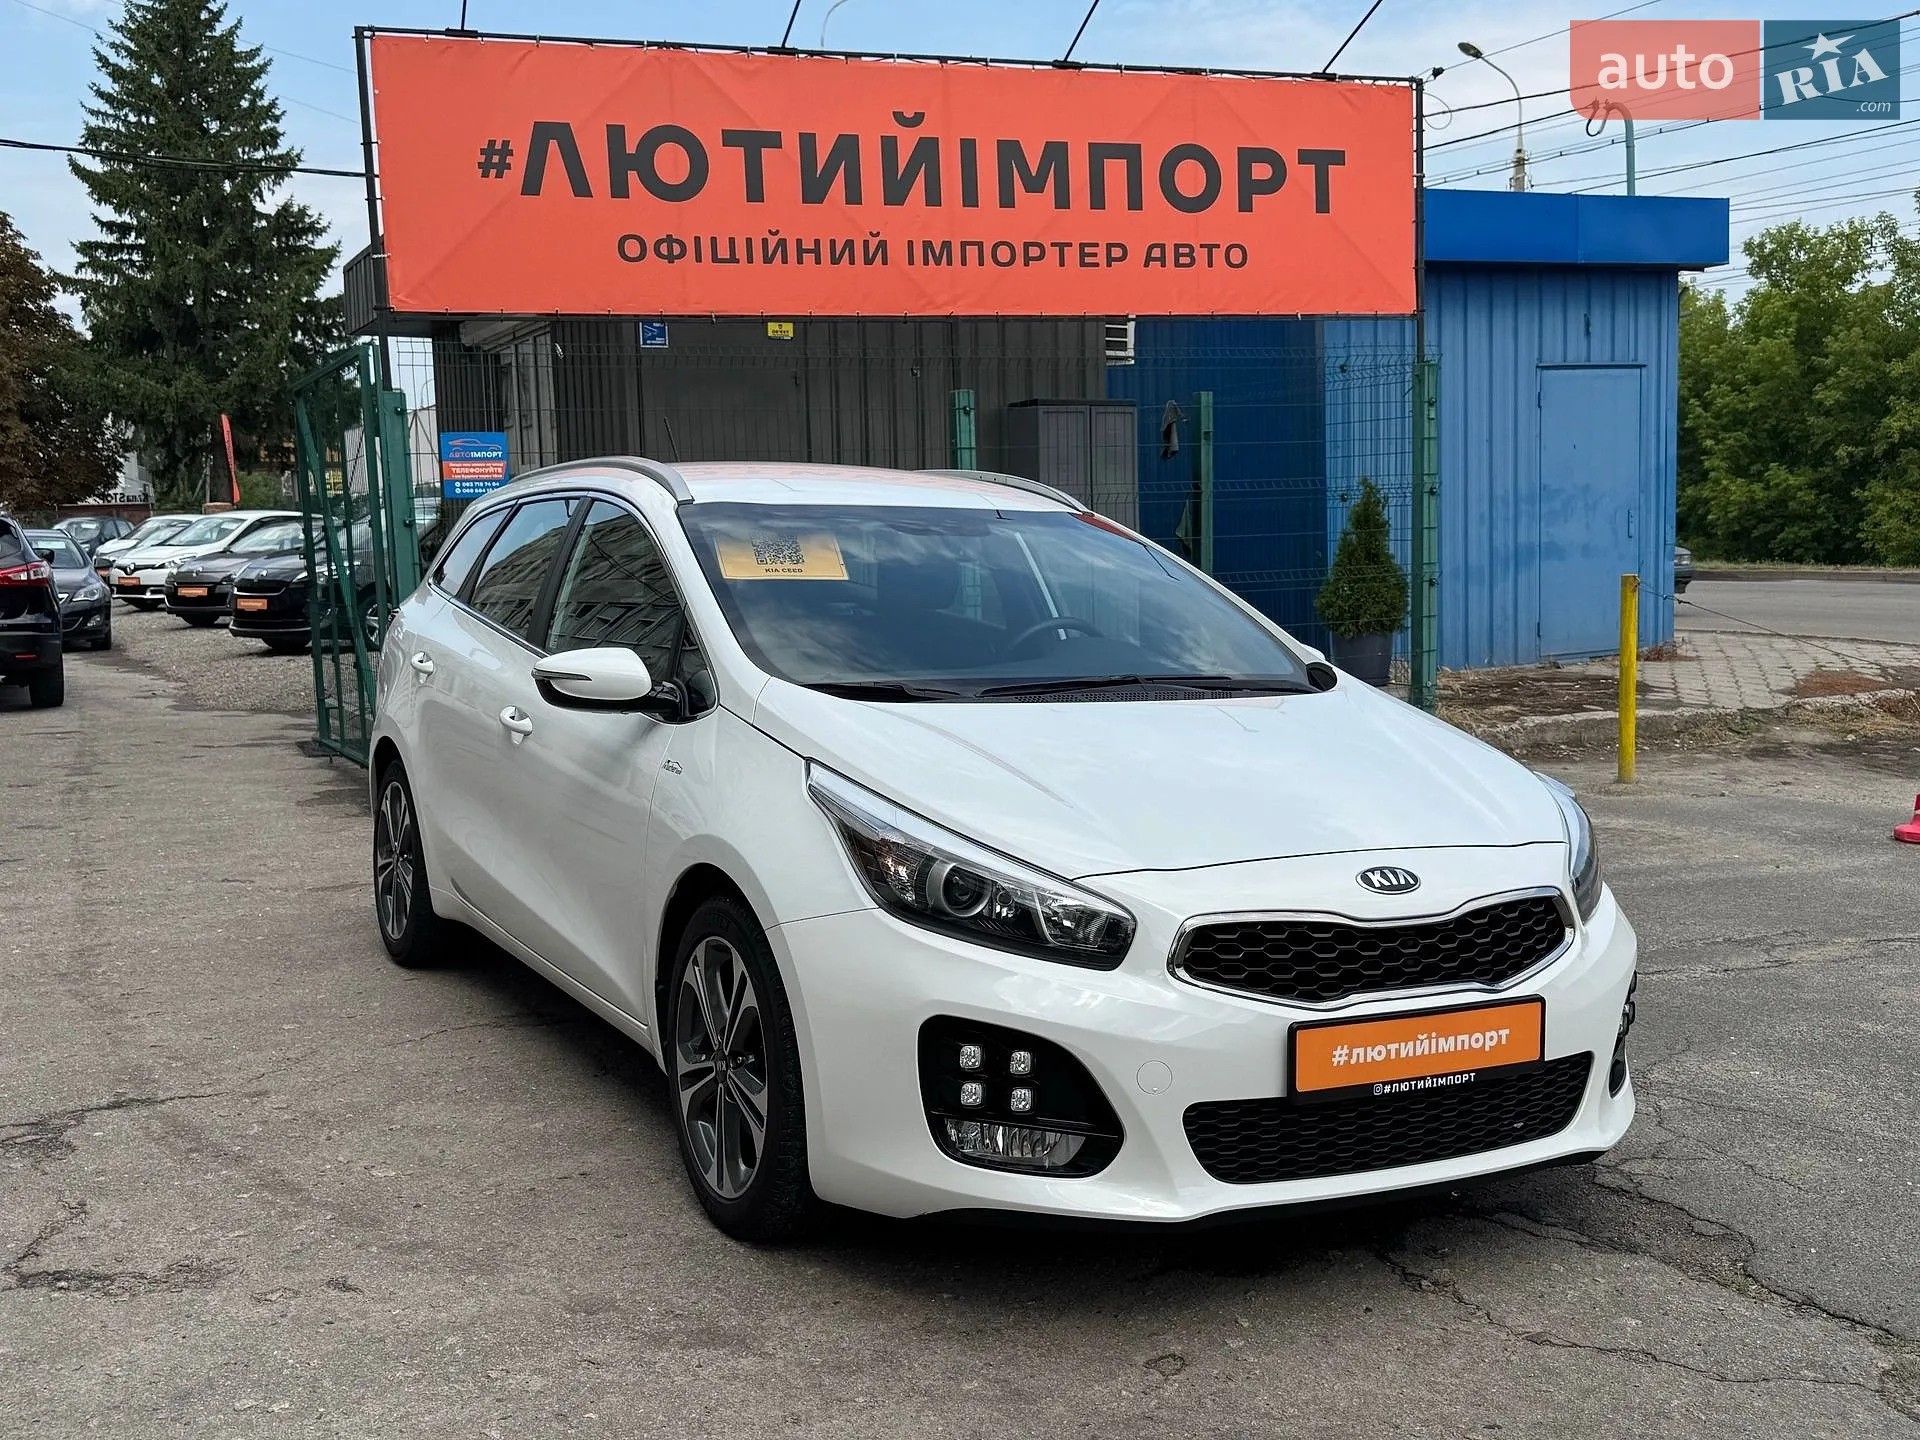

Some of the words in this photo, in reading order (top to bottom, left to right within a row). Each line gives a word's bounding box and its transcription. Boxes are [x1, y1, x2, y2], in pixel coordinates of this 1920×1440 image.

[477, 109, 1347, 215] #ЛЮТИЙІМПОРТ
[617, 229, 889, 266] ОФІЦІЙНИЙ
[906, 238, 1129, 269] ІМПОРТЕР
[1143, 242, 1249, 269] АВТО
[1364, 869, 1416, 888] KIA
[1331, 1028, 1510, 1067] #лютийімпорт
